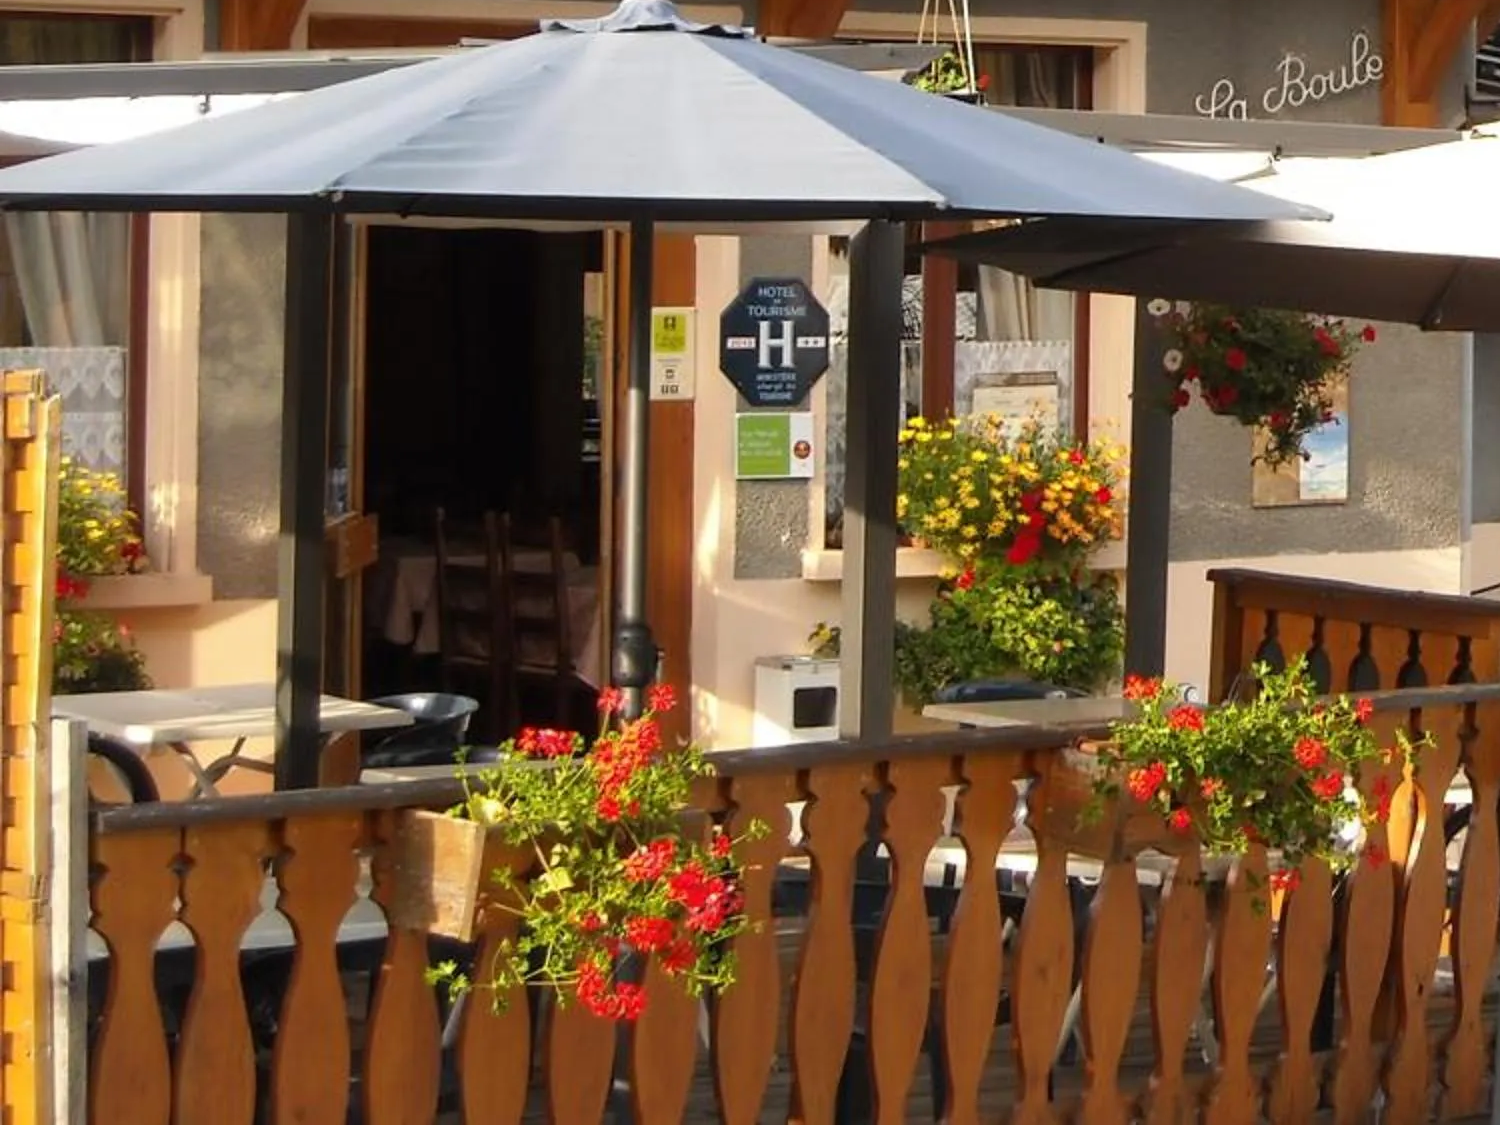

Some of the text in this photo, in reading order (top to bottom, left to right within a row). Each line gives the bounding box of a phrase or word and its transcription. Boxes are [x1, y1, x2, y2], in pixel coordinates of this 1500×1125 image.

[1263, 33, 1384, 113] Boule
[758, 286, 796, 297] HOTEL
[747, 306, 807, 316] TOURISME
[758, 320, 795, 368] H
